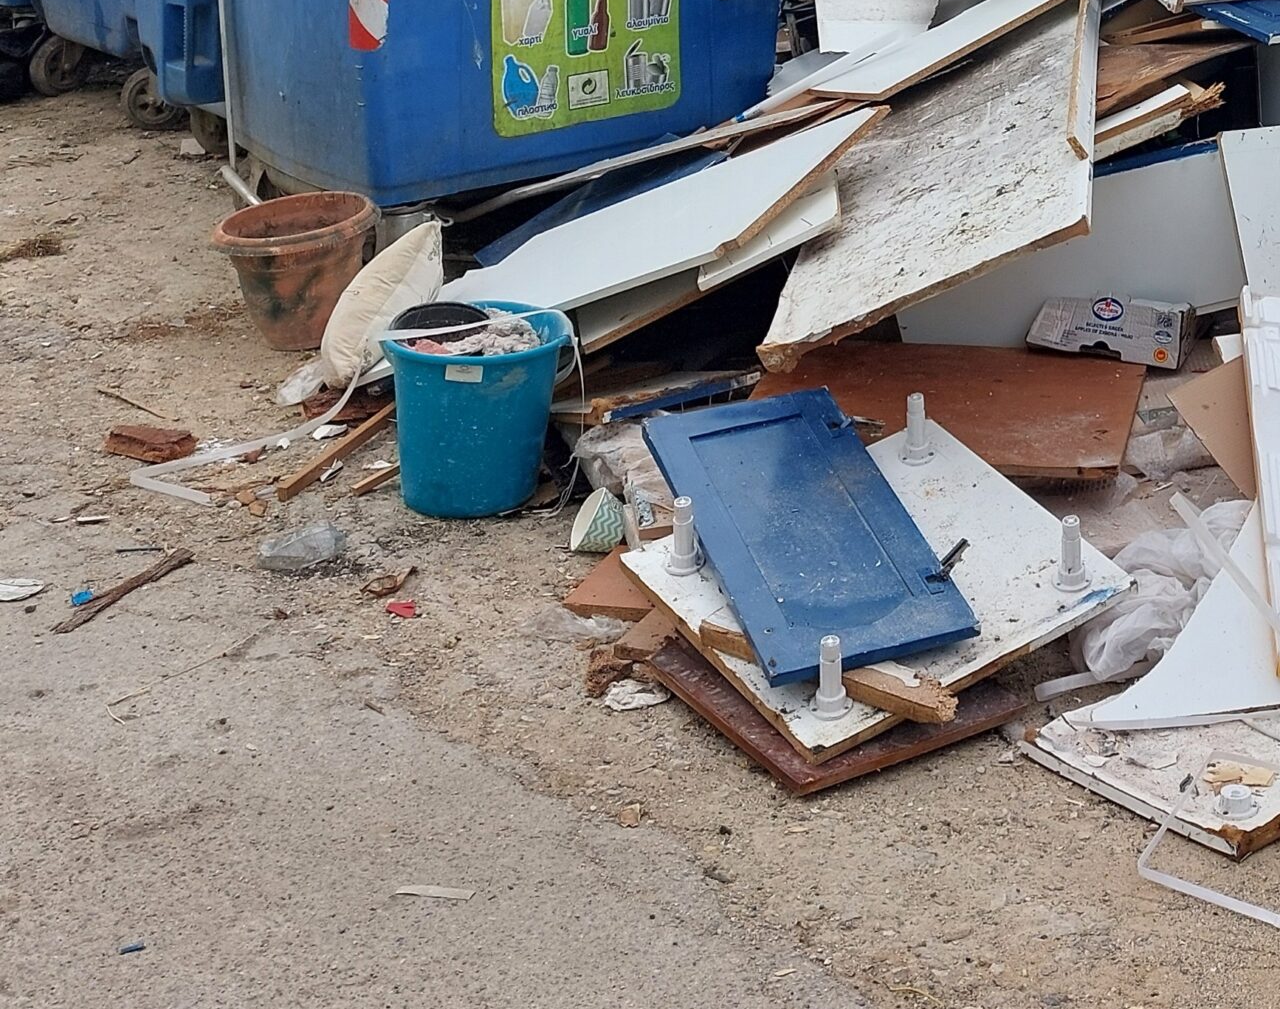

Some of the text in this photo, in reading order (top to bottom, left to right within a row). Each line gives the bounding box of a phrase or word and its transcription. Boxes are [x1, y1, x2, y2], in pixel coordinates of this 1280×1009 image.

[626, 14, 670, 29] αλουμίνιο
[572, 23, 598, 39] γυαλί
[518, 32, 543, 47] χαρτί
[517, 99, 558, 116] πλαστικό
